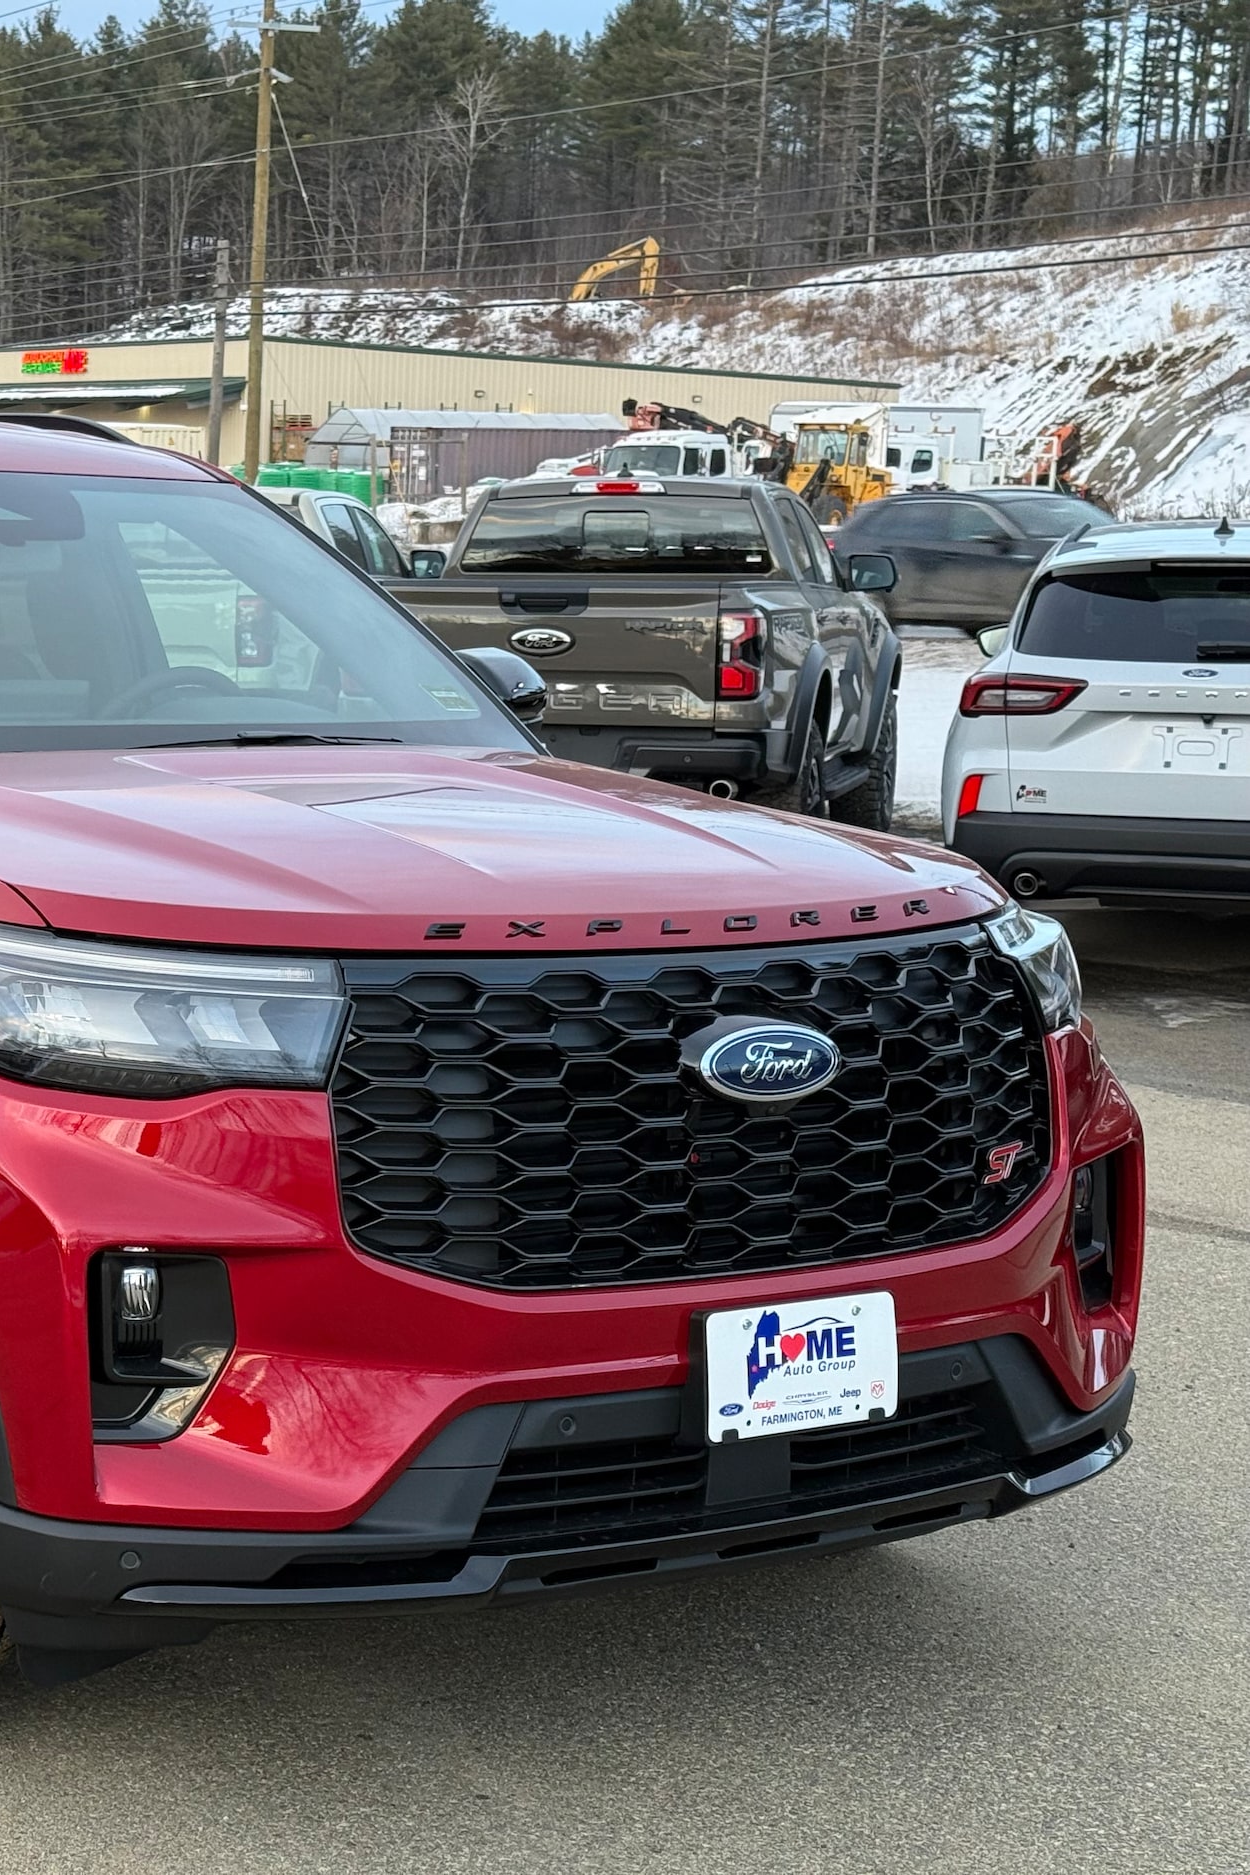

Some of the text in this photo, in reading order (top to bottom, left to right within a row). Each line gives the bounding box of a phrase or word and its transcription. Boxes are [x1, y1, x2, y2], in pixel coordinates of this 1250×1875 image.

[424, 898, 930, 939] EXPLORER
[740, 1041, 813, 1083] Ford
[983, 1141, 1023, 1184] ST
[783, 1358, 856, 1377] Auto Group
[785, 1390, 829, 1400] CHRYSLER
[840, 1388, 861, 1398] Jeep
[752, 1399, 776, 1411] Dodge
[761, 1405, 843, 1426] FARMINGTON, ME
